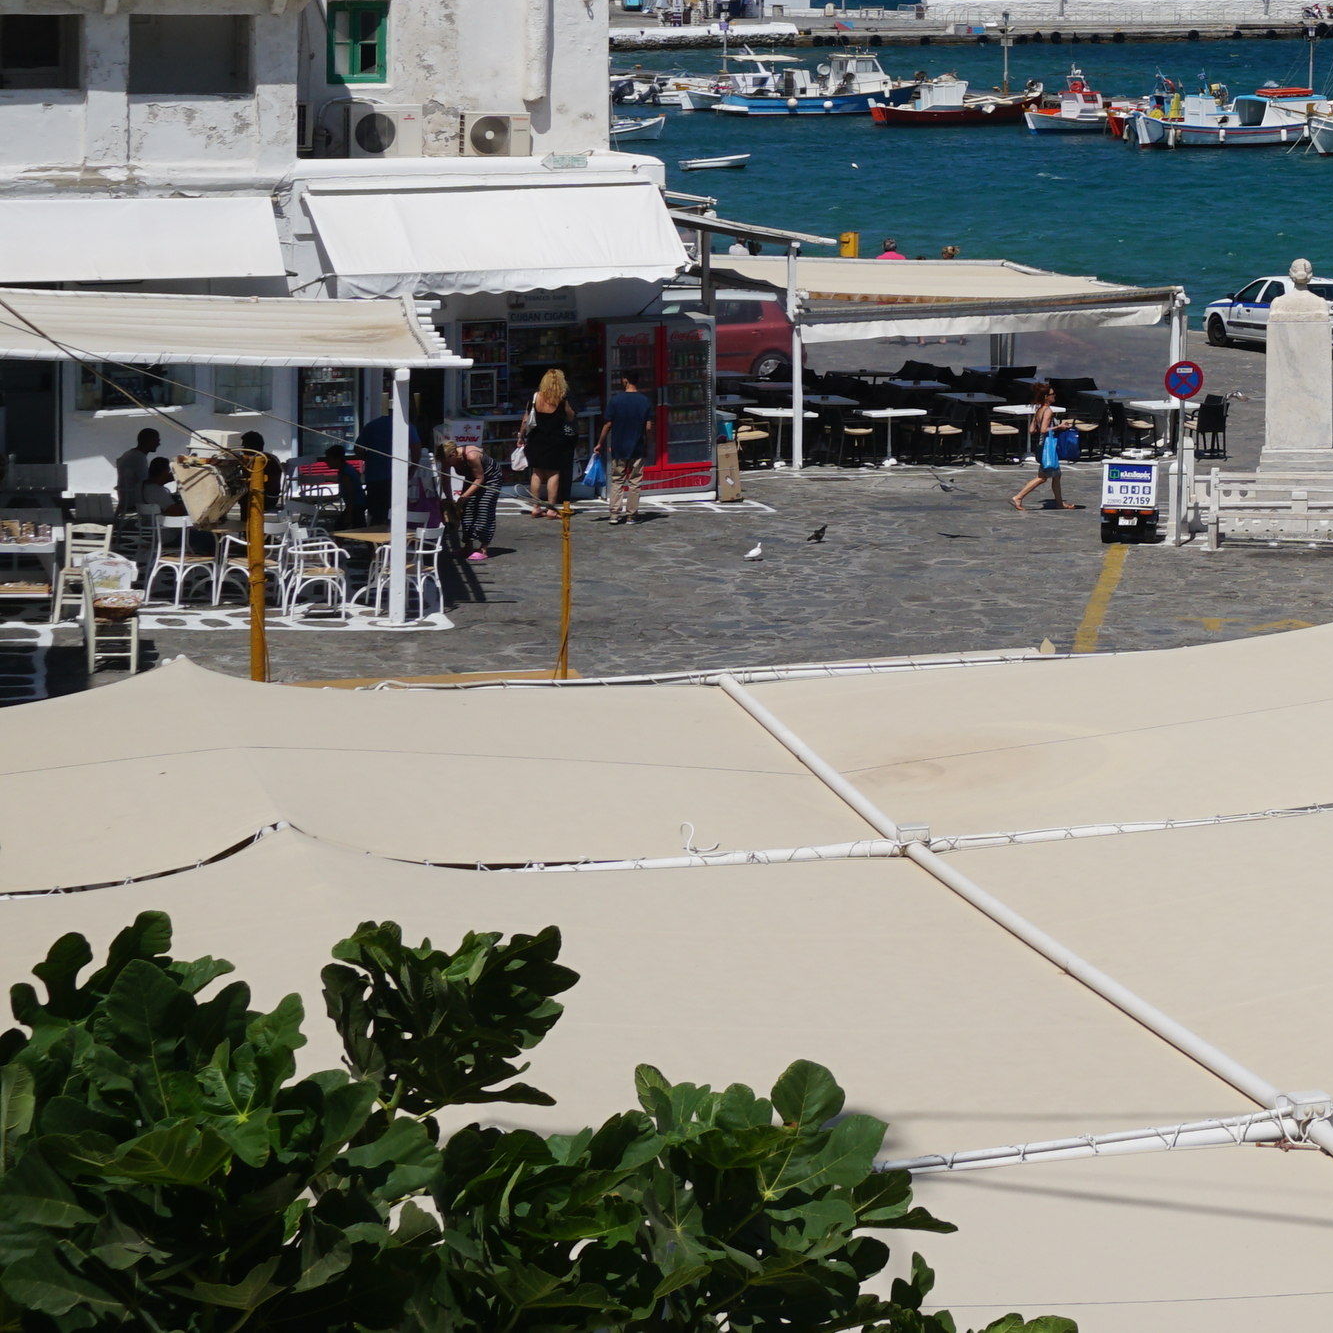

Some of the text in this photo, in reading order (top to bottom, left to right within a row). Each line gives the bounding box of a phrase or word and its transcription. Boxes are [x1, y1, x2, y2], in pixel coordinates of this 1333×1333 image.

[510, 311, 577, 322] CUBAN CIGARS
[1122, 496, 1151, 505] 27.159
